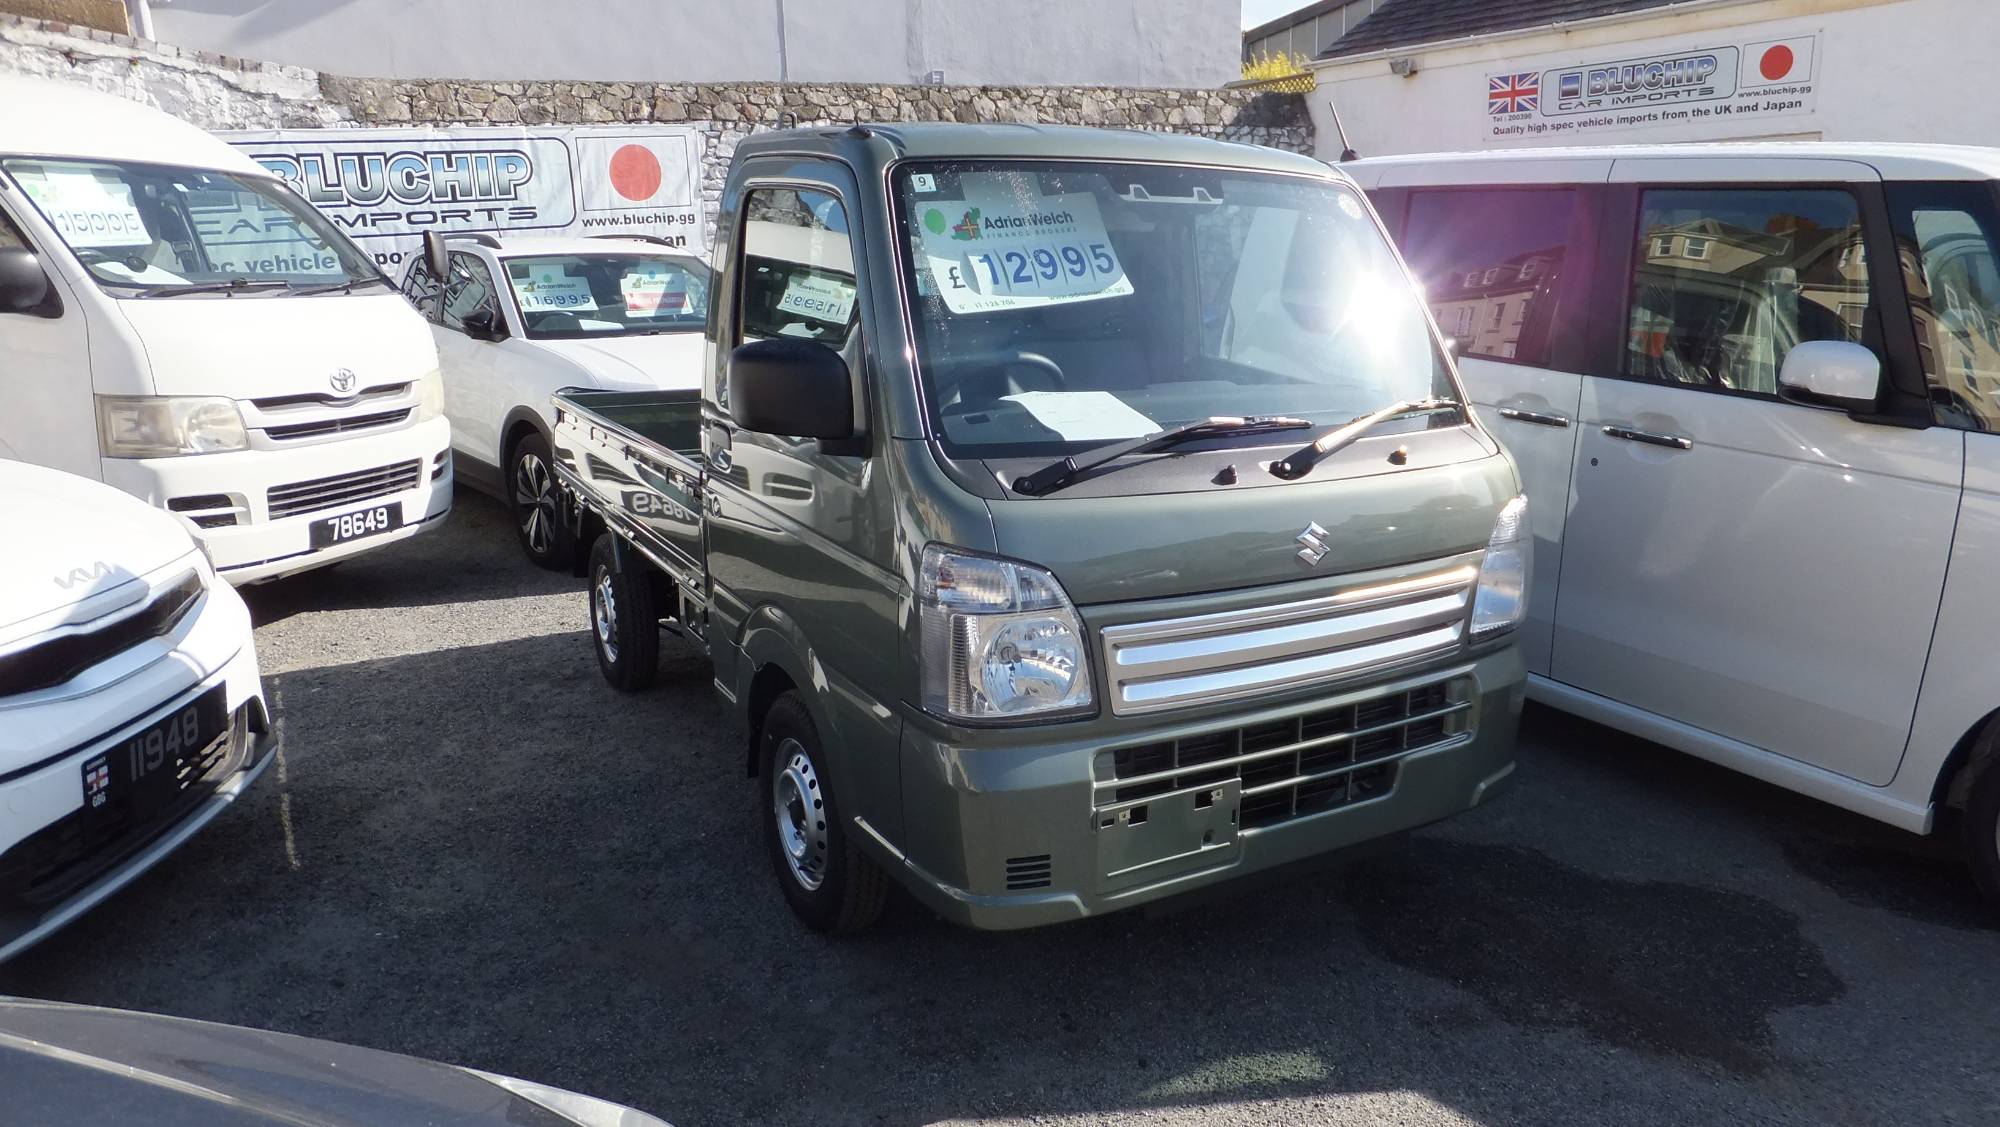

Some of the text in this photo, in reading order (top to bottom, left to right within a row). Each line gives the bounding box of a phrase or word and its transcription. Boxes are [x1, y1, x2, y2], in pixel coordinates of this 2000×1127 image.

[1588, 55, 1717, 98] BLUCHIP
[1558, 86, 1715, 111] CAR IMPORTS
[1738, 86, 1812, 98] www.bluchip.gg
[1493, 100, 1802, 136] Quality high spec vehicle imports from the UK and Japan
[918, 176, 927, 187] 9
[327, 206, 538, 230] MPORTS
[582, 213, 696, 228] www.bluchip.gg
[245, 253, 336, 274] vehicle
[327, 507, 389, 541] 78649
[129, 705, 200, 782] 11948
